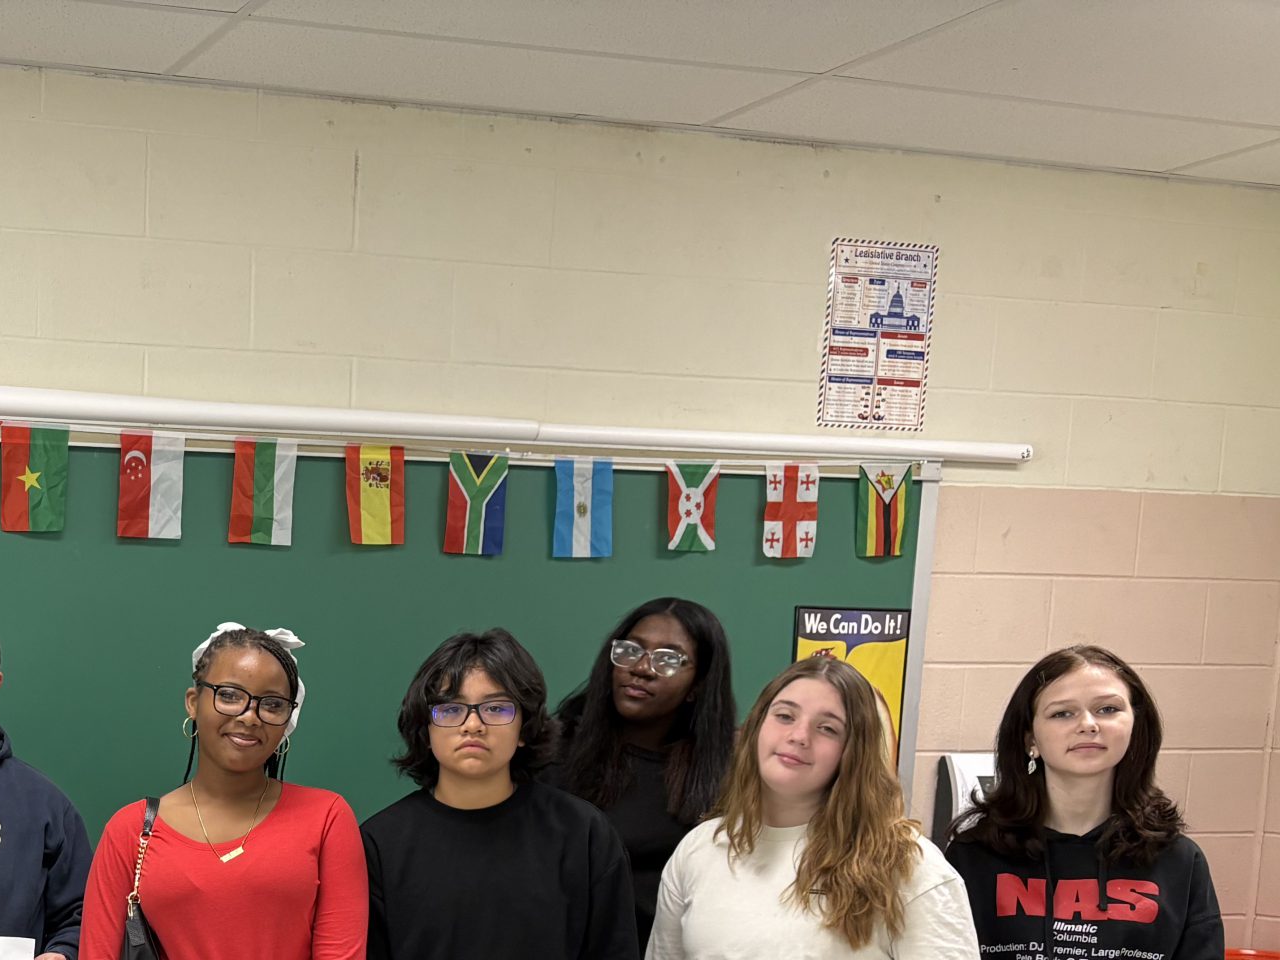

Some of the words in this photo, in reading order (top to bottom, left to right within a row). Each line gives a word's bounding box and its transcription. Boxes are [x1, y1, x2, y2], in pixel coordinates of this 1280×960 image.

[854, 249, 894, 260] Legislative
[895, 252, 921, 262] Branch
[804, 612, 828, 634] We
[830, 613, 858, 634] Can
[860, 614, 882, 634] Do
[884, 614, 902, 635] It!
[996, 873, 1160, 924] NAS
[980, 942, 1026, 954] Production:
[1029, 942, 1044, 952] DJ
[1052, 946, 1088, 958] remier,
[1091, 948, 1121, 958] Large
